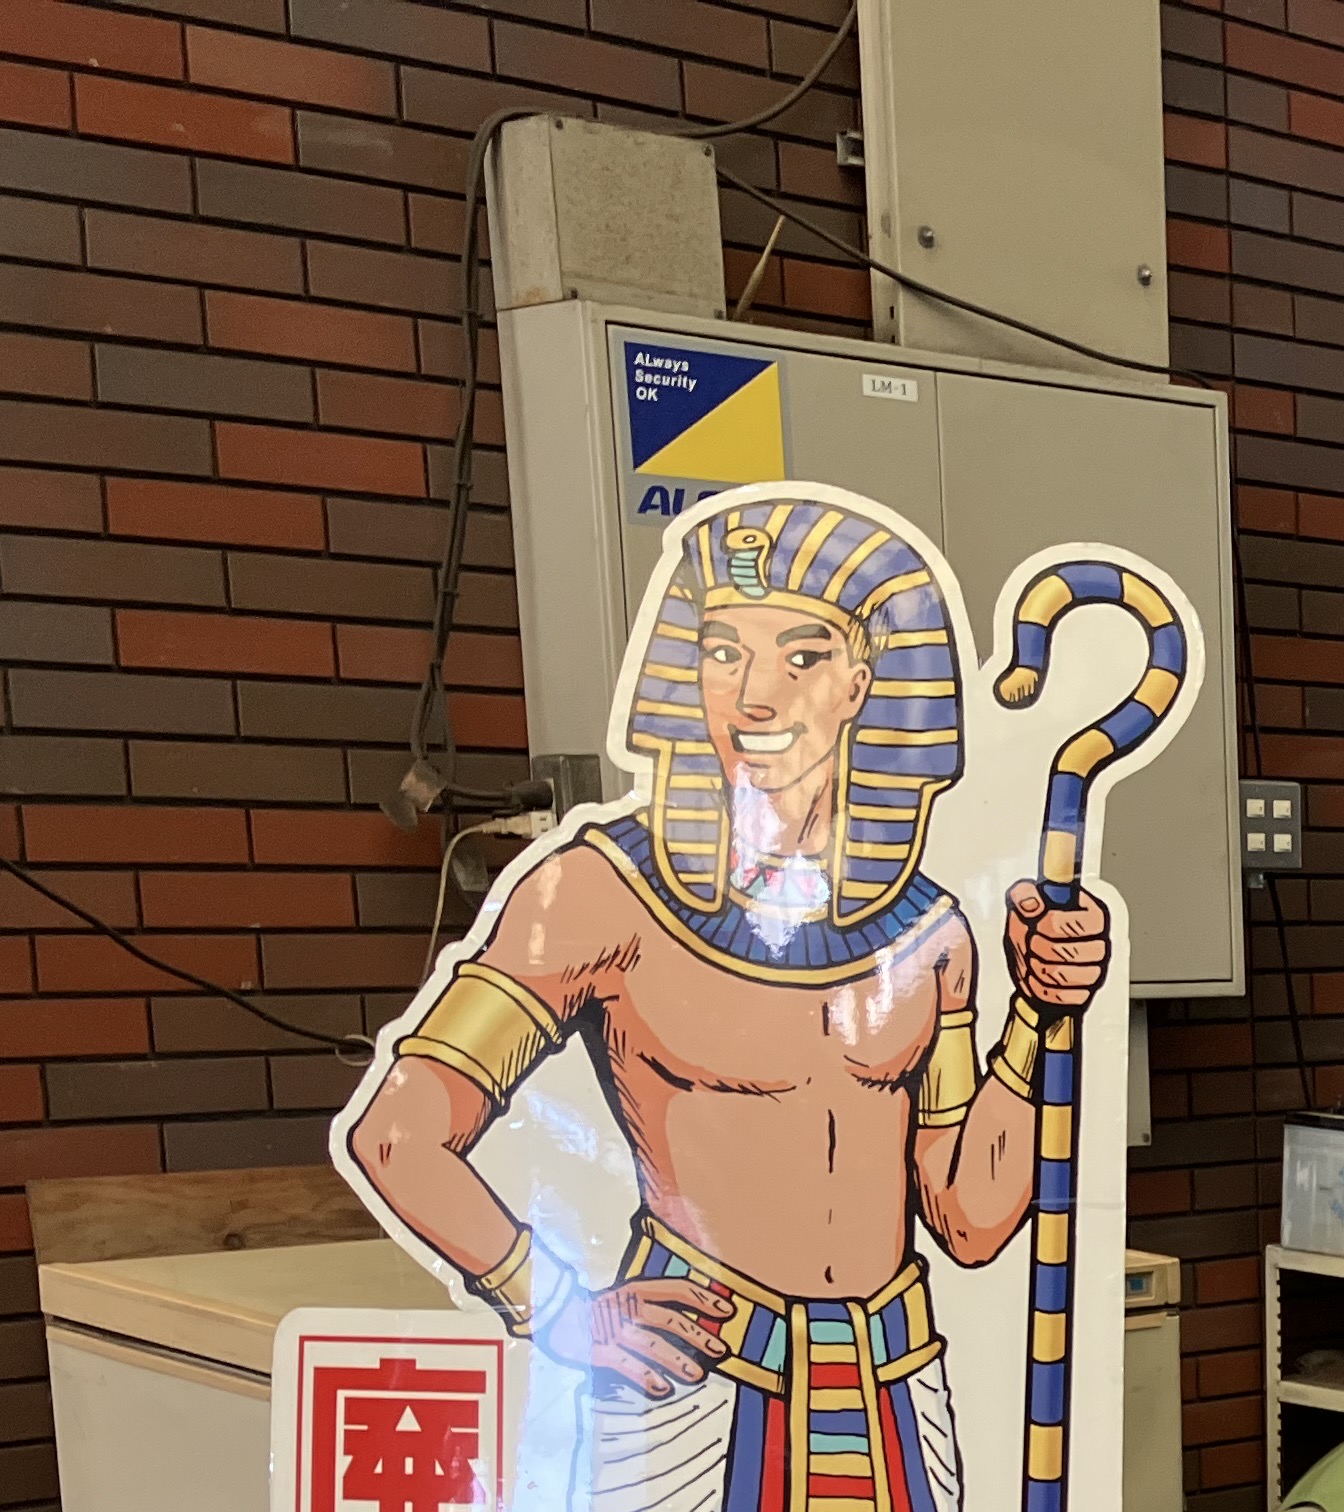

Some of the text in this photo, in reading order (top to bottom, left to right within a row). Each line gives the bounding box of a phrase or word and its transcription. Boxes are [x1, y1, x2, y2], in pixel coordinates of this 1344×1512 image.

[634, 352, 689, 373] ALways
[634, 369, 697, 393] Security
[871, 379, 907, 396] LM-1
[635, 387, 659, 402] OK
